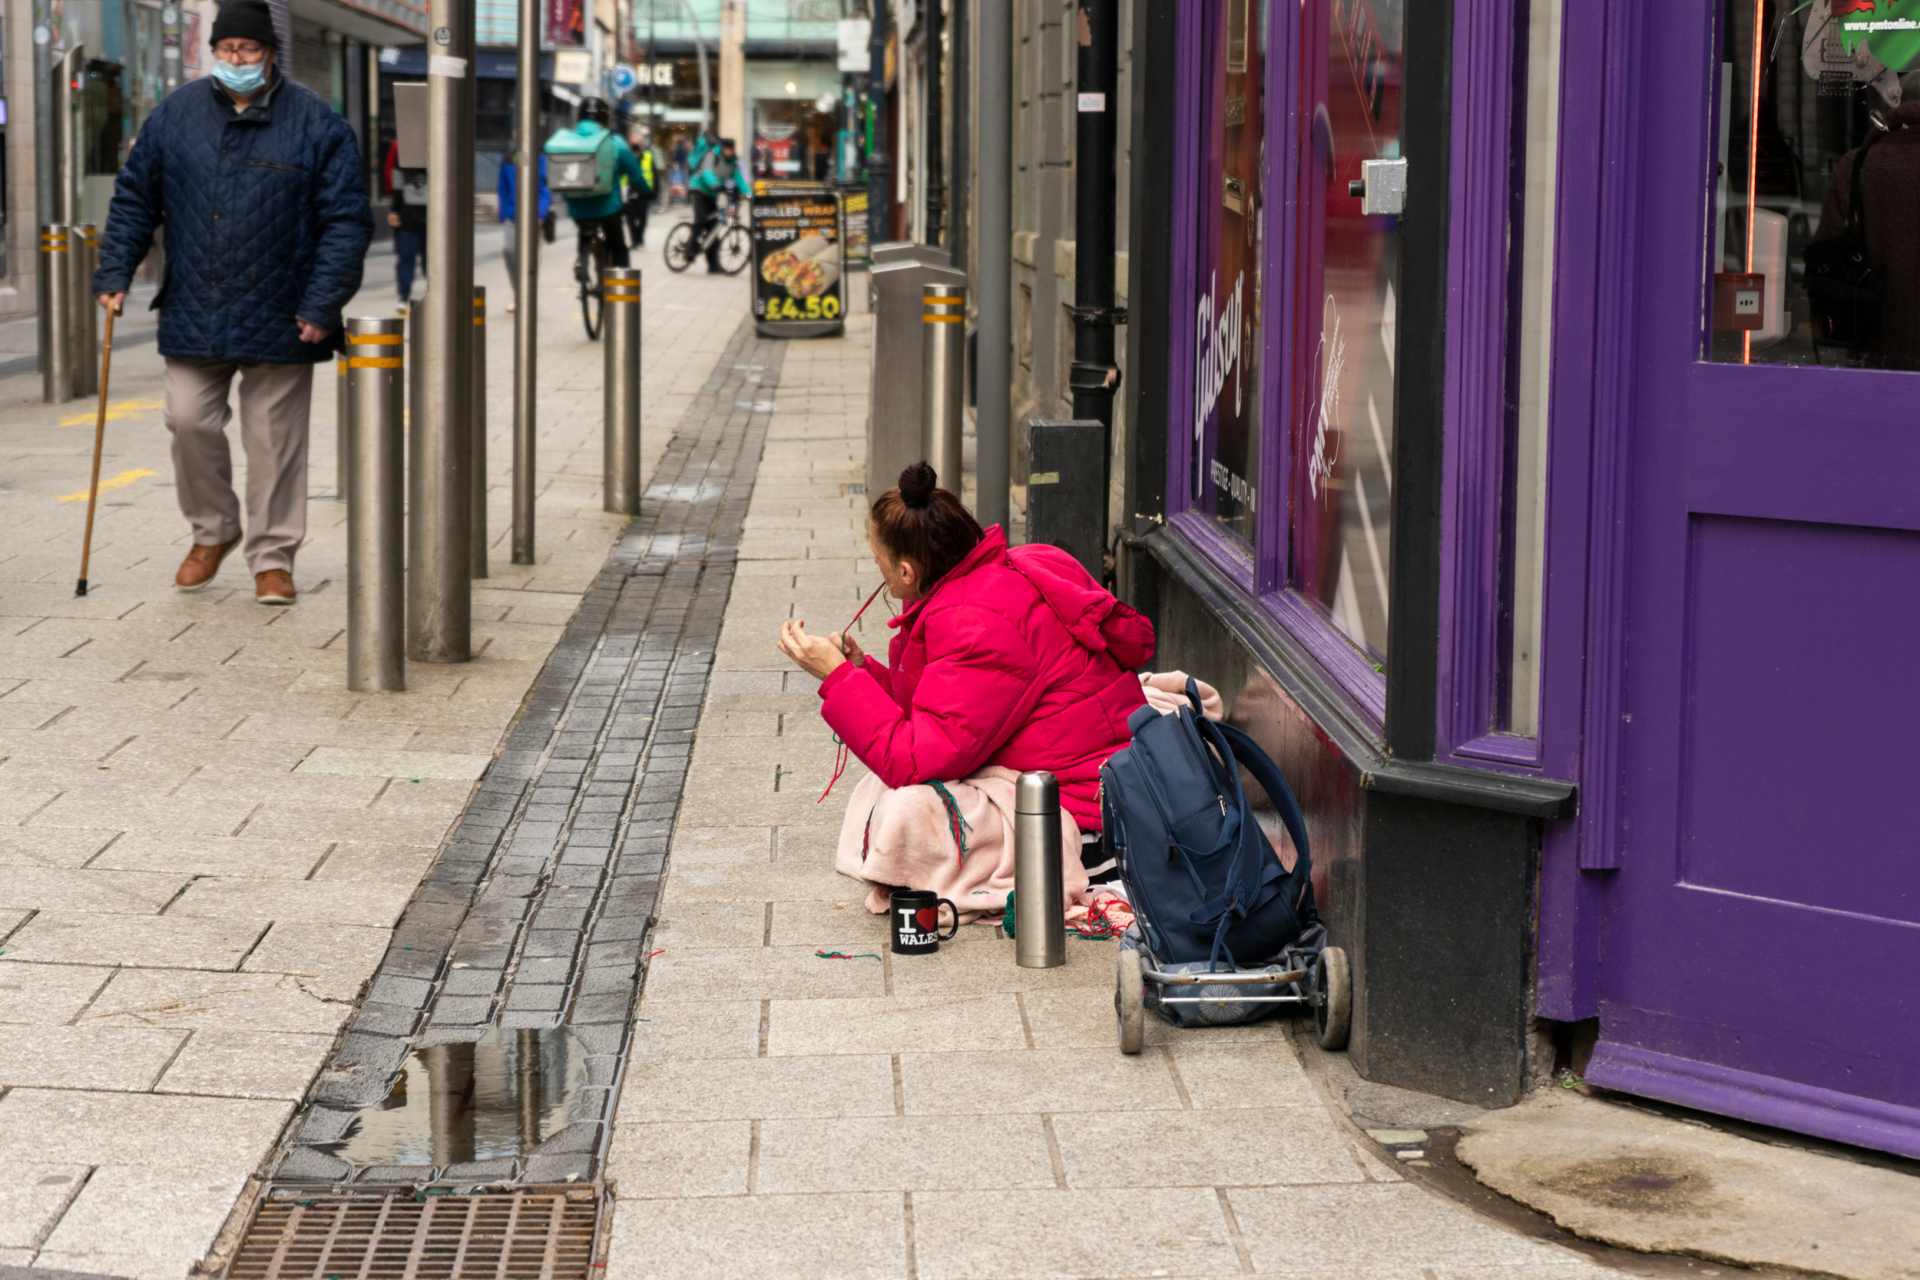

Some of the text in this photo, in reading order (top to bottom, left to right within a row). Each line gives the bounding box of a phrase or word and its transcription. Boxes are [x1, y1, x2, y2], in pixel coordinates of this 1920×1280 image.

[1844, 18, 1920, 33] www.pmtonline.
[754, 205, 836, 217] GRILLED WRAP
[762, 220, 797, 228] WEDGES
[798, 219, 810, 227] OR
[811, 218, 836, 226] CHIPS
[765, 229, 797, 240] SOFT
[799, 228, 837, 239] DRIK
[765, 295, 840, 320] £4.50
[1195, 268, 1245, 498] Gibson
[898, 908, 917, 933] I
[899, 931, 939, 945] WALES
